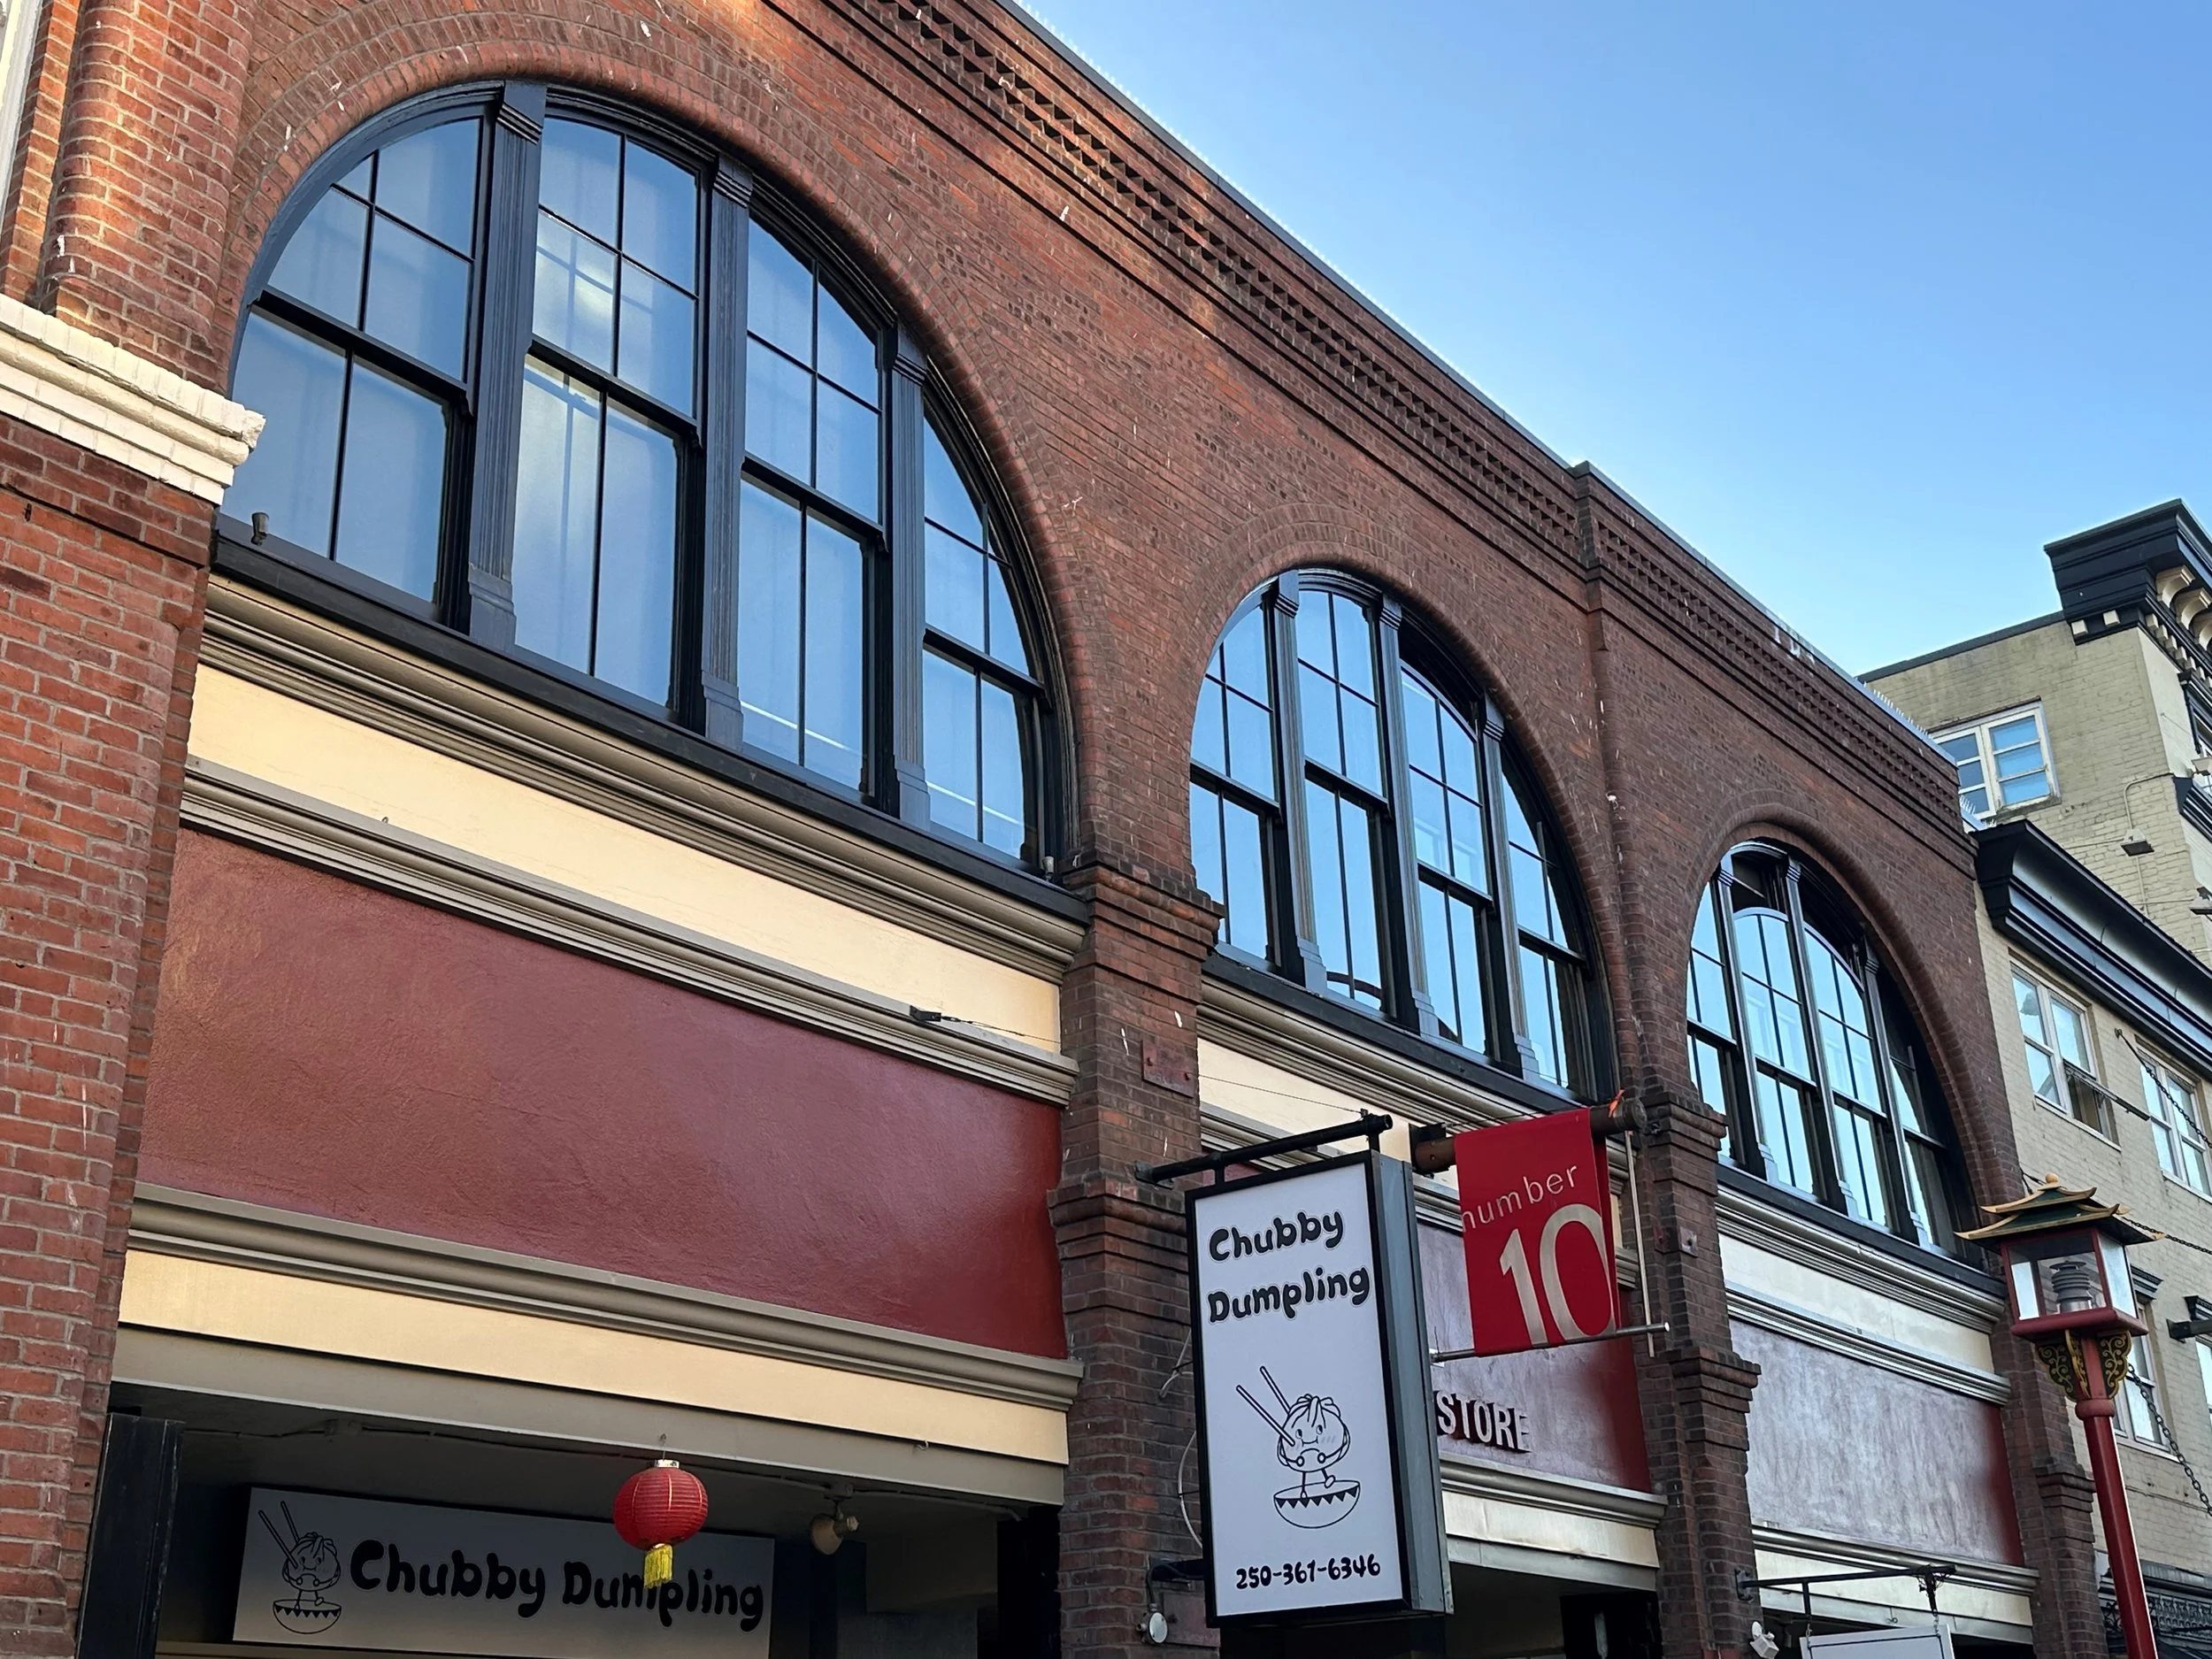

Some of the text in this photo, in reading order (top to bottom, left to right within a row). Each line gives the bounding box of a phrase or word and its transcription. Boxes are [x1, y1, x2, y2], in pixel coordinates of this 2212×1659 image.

[1462, 1165, 1577, 1232] number
[1210, 1211, 1343, 1261] Chubby
[1208, 1267, 1370, 1323] Dumpling
[1499, 1203, 1617, 1347] 10
[1435, 1390, 1532, 1452] STORE
[350, 1539, 764, 1632] Chubby Dumpling
[1236, 1554, 1380, 1589] 250-361-6346
